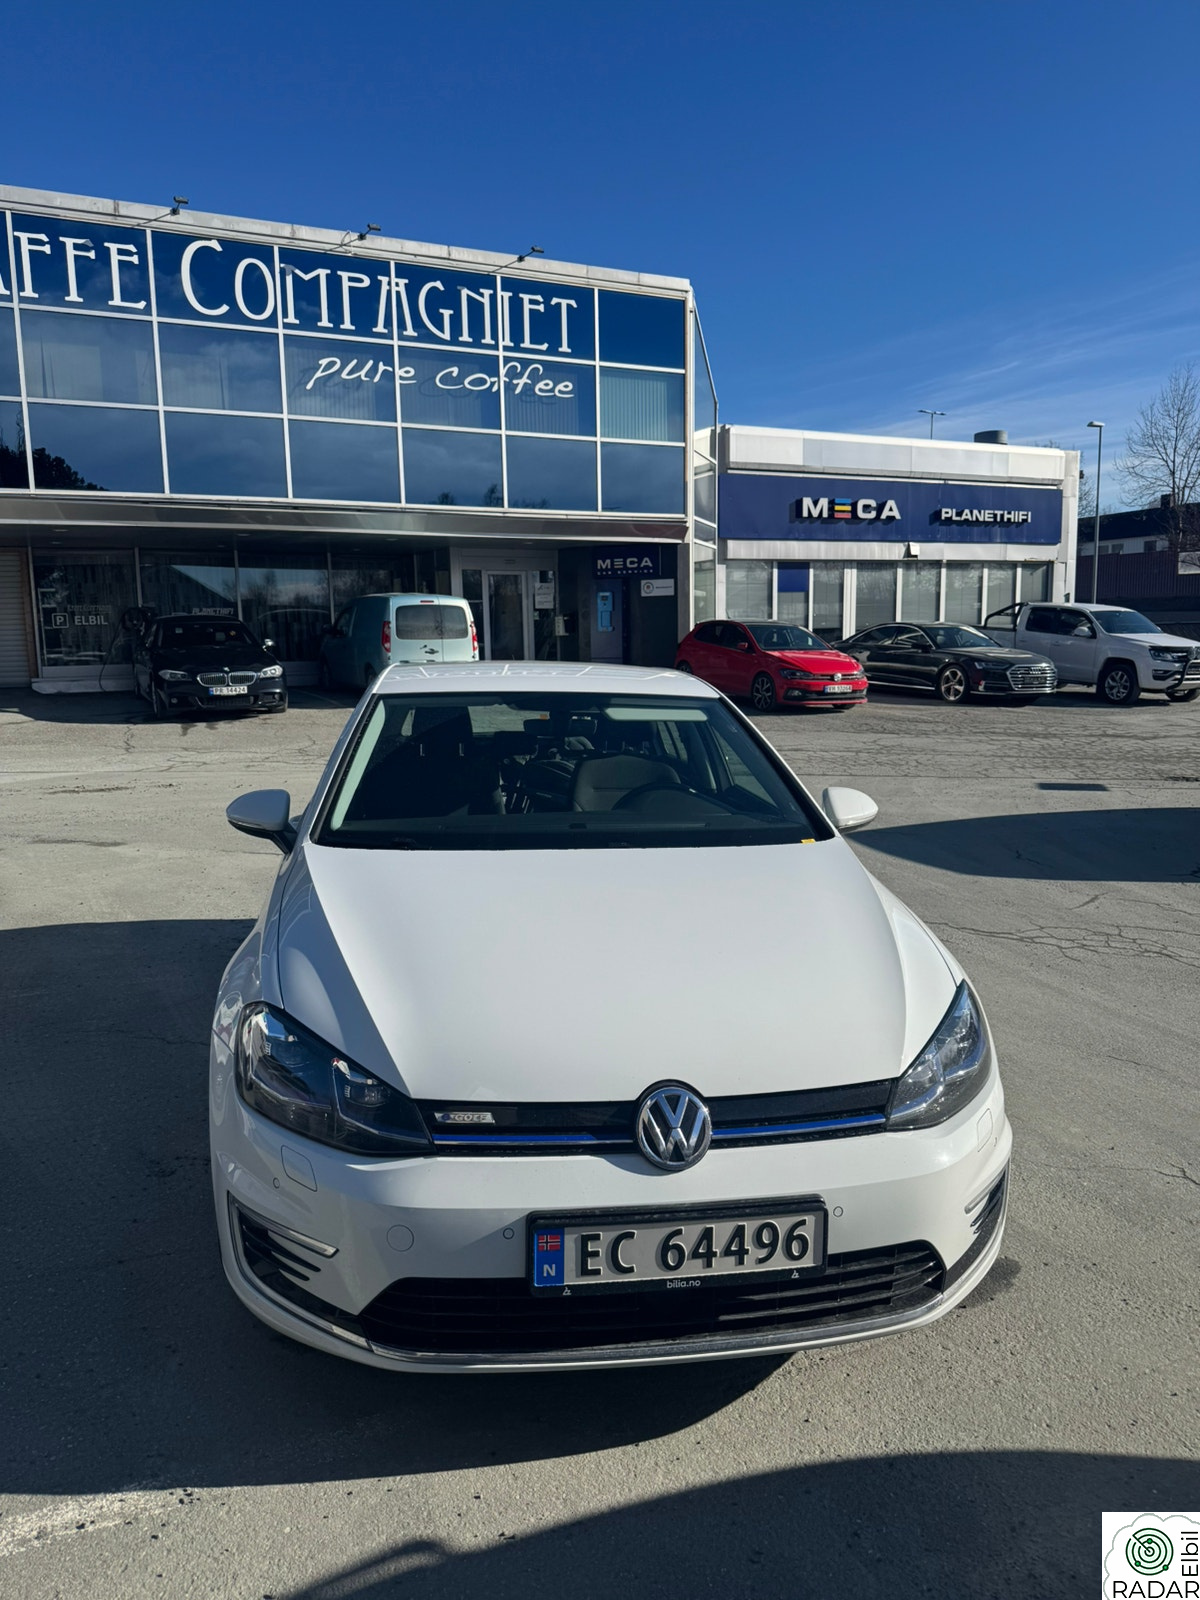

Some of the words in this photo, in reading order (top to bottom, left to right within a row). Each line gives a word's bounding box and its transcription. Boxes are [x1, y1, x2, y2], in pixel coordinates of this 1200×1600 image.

[306, 357, 417, 390] pure
[435, 361, 575, 398] coffee
[802, 497, 901, 520] MECA
[941, 508, 1032, 523] PLANETHIFI
[597, 557, 653, 569] MECA
[74, 615, 109, 626] ELBIL
[578, 1230, 637, 1278] EC
[659, 1217, 811, 1272] 64496
[543, 1264, 556, 1278] N
[666, 1279, 702, 1290] bilia.no
